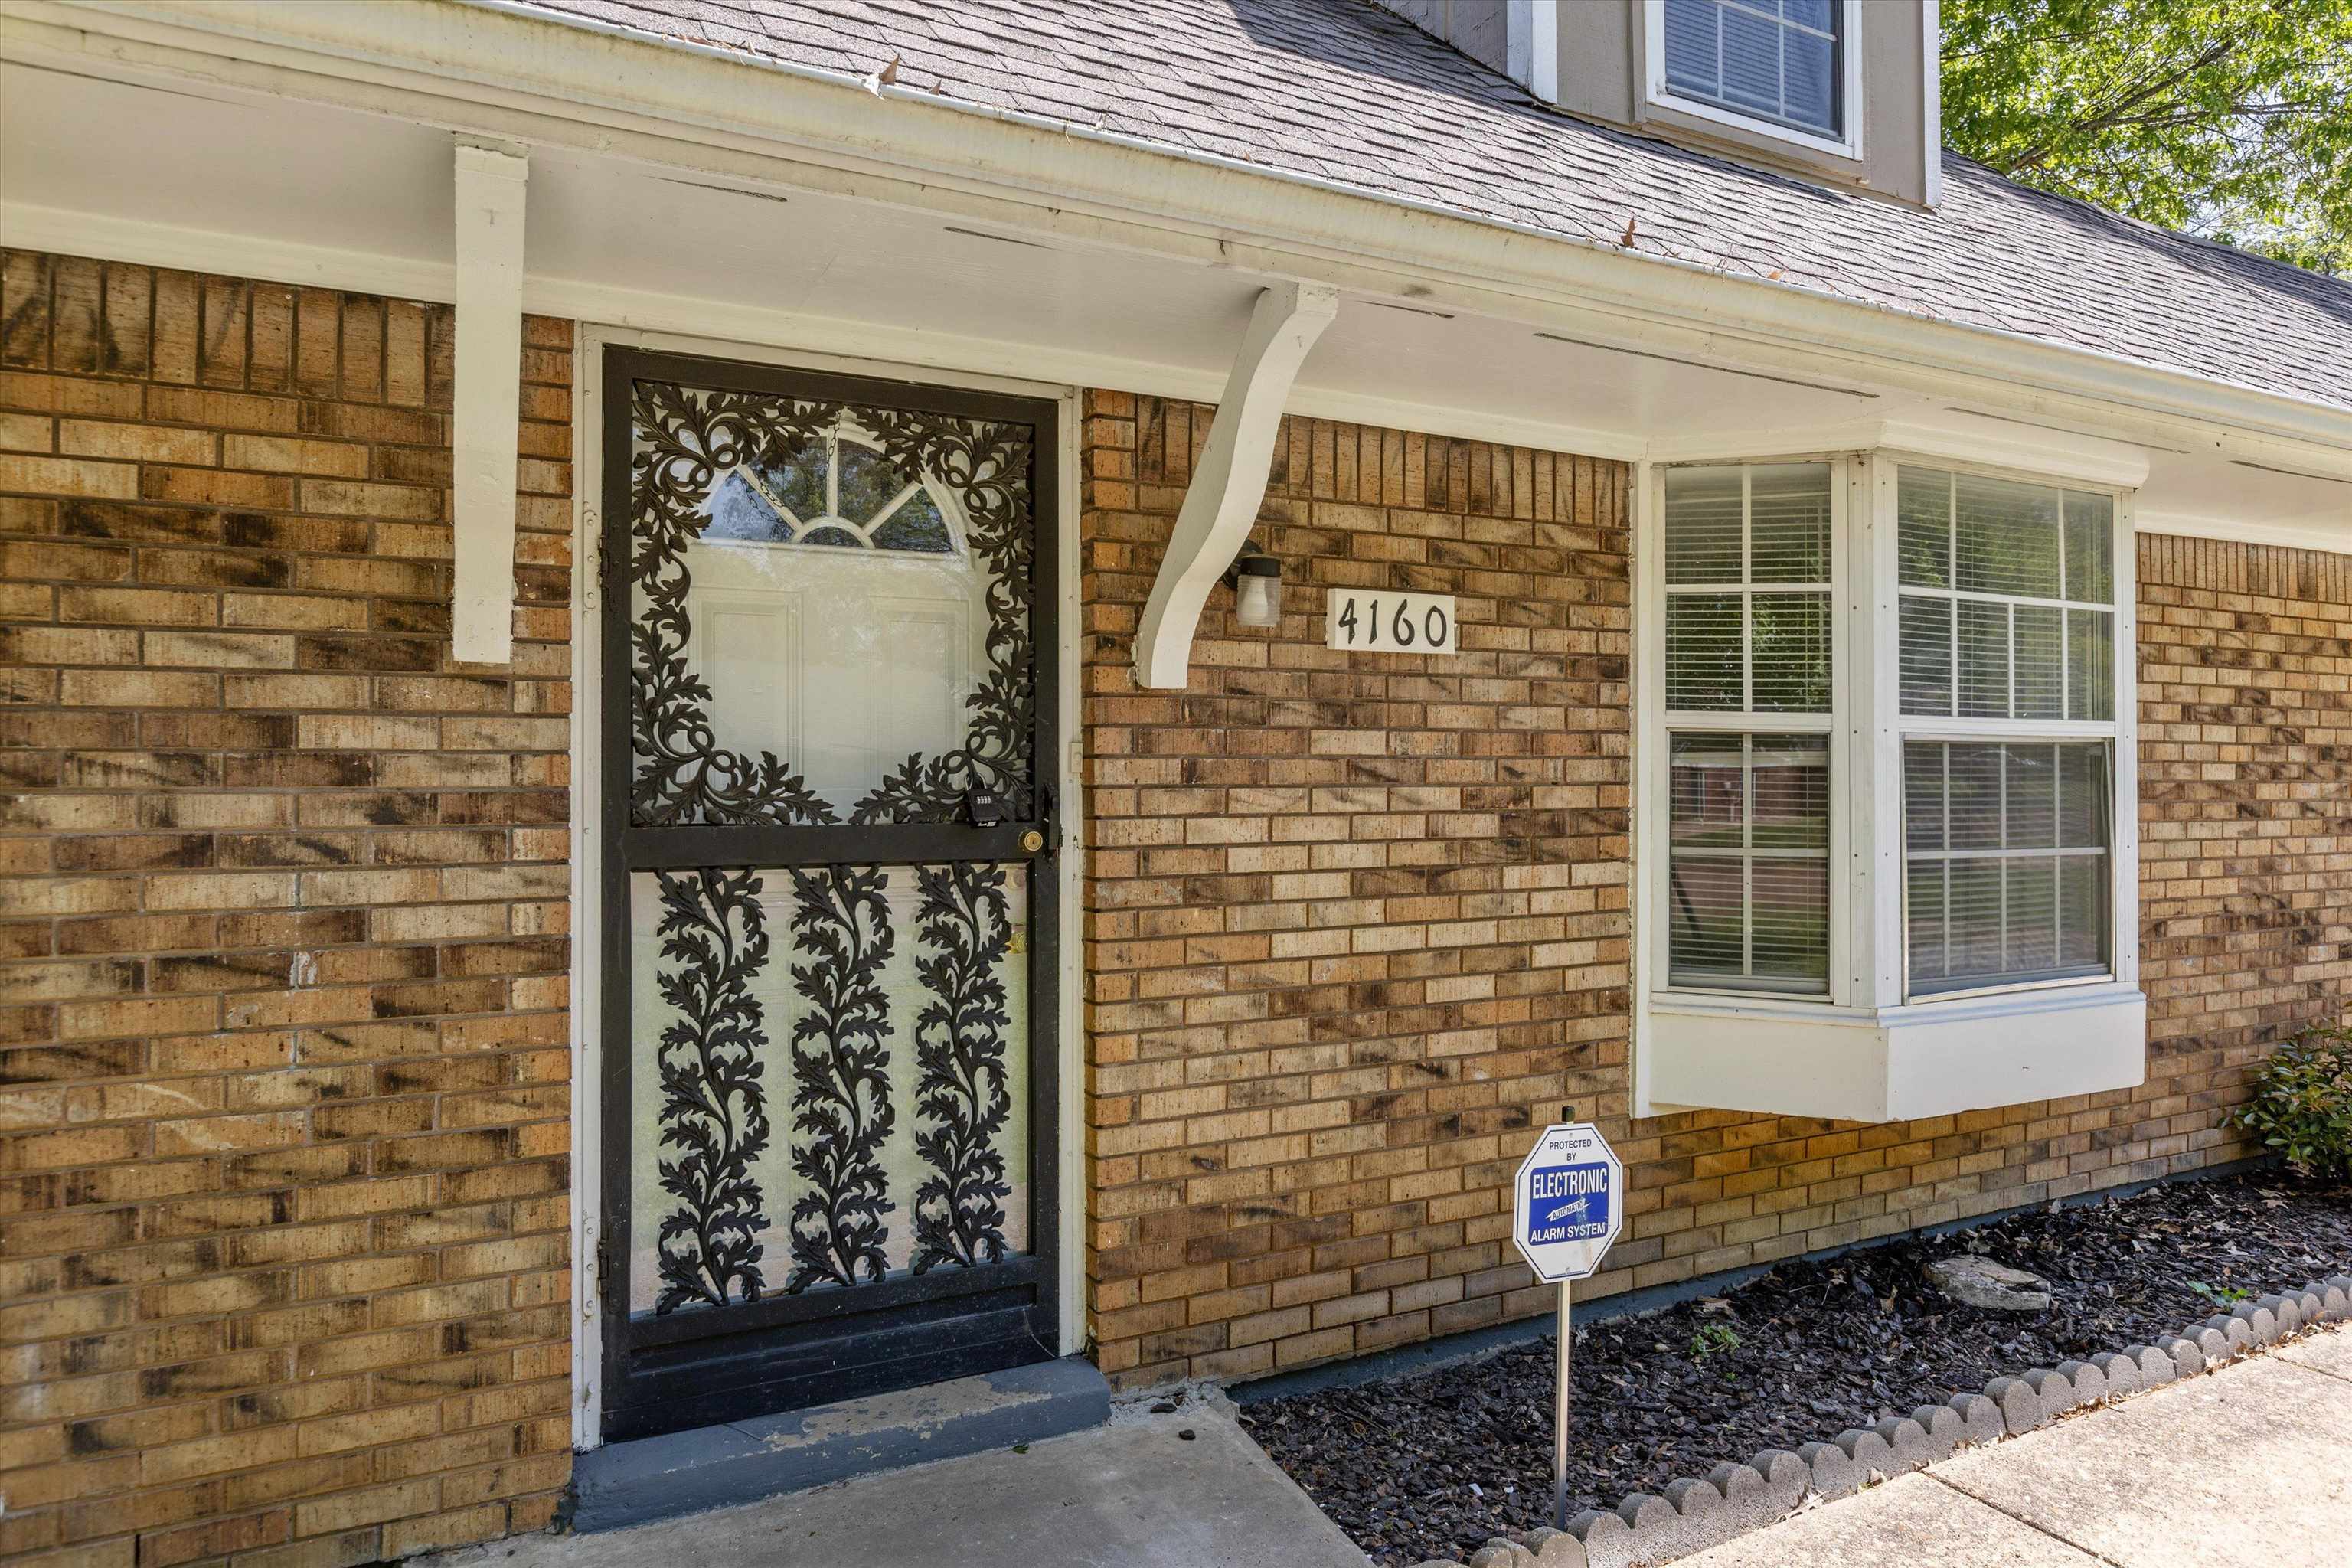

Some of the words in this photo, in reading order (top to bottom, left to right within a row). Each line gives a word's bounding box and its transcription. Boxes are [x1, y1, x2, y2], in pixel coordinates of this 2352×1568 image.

[1338, 598, 1447, 647] 4160
[1549, 1138, 1592, 1150] PROTECTED
[1566, 1152, 1576, 1161] BY
[1533, 1168, 1607, 1199] ELECTRONIC
[1553, 1201, 1583, 1220] AUTOMATIC
[1530, 1226, 1565, 1243] ALARM
[1567, 1222, 1606, 1238] SYSTEM
